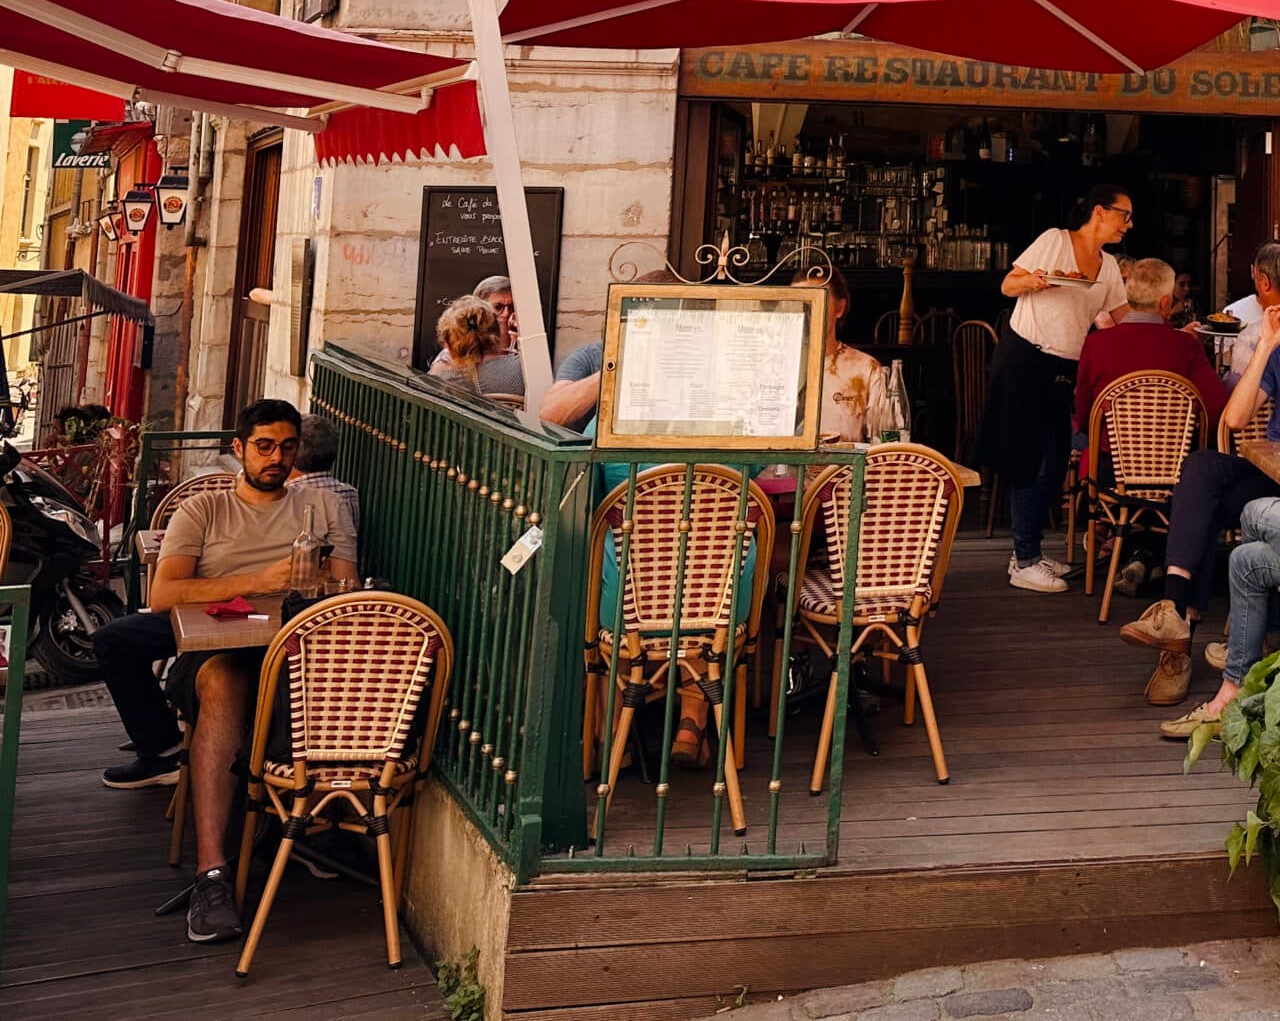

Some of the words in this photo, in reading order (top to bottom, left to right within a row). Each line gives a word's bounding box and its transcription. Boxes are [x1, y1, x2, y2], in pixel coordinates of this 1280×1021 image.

[698, 51, 811, 81] CAFE
[823, 55, 1102, 92] RESTAURANT
[1118, 67, 1176, 95] DU
[54, 152, 109, 167] Laverie
